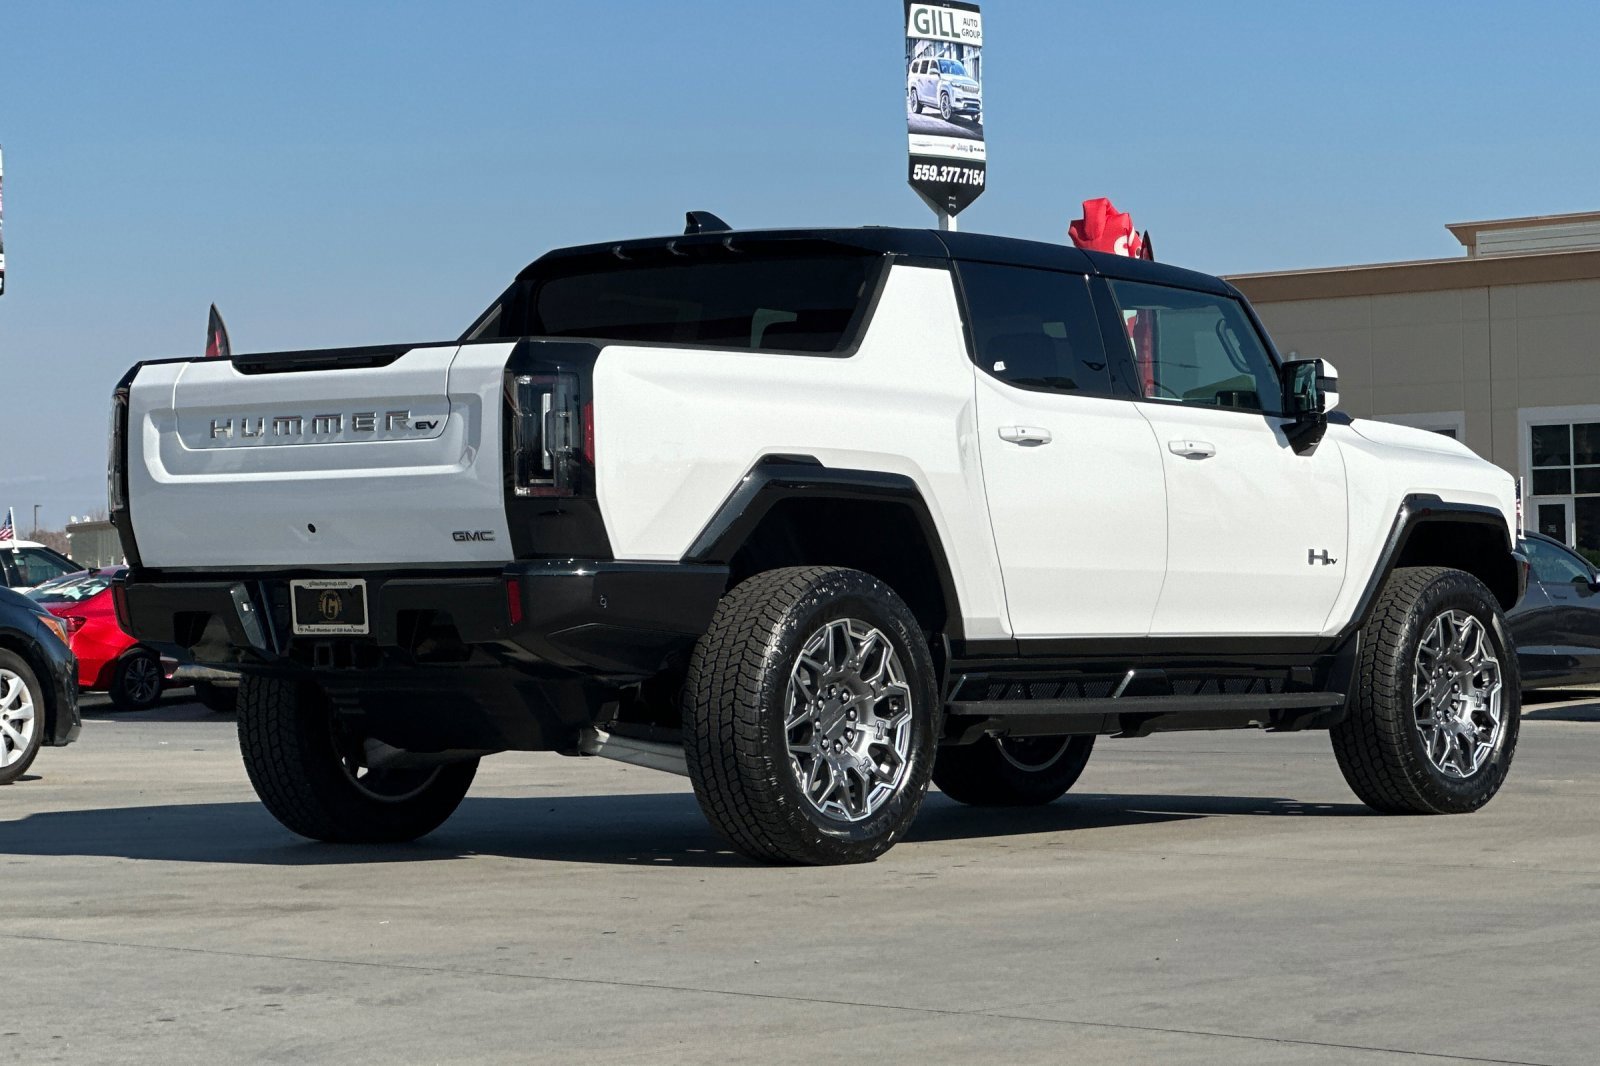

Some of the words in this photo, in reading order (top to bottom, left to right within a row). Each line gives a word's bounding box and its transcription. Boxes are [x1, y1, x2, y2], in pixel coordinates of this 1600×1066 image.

[914, 8, 960, 38] GILL
[963, 18, 978, 28] AUTO
[961, 28, 980, 39] GROUP
[913, 164, 984, 186] 559.377.7154
[210, 409, 412, 439] HUMMER
[415, 420, 438, 430] EV
[452, 531, 495, 541] GMC
